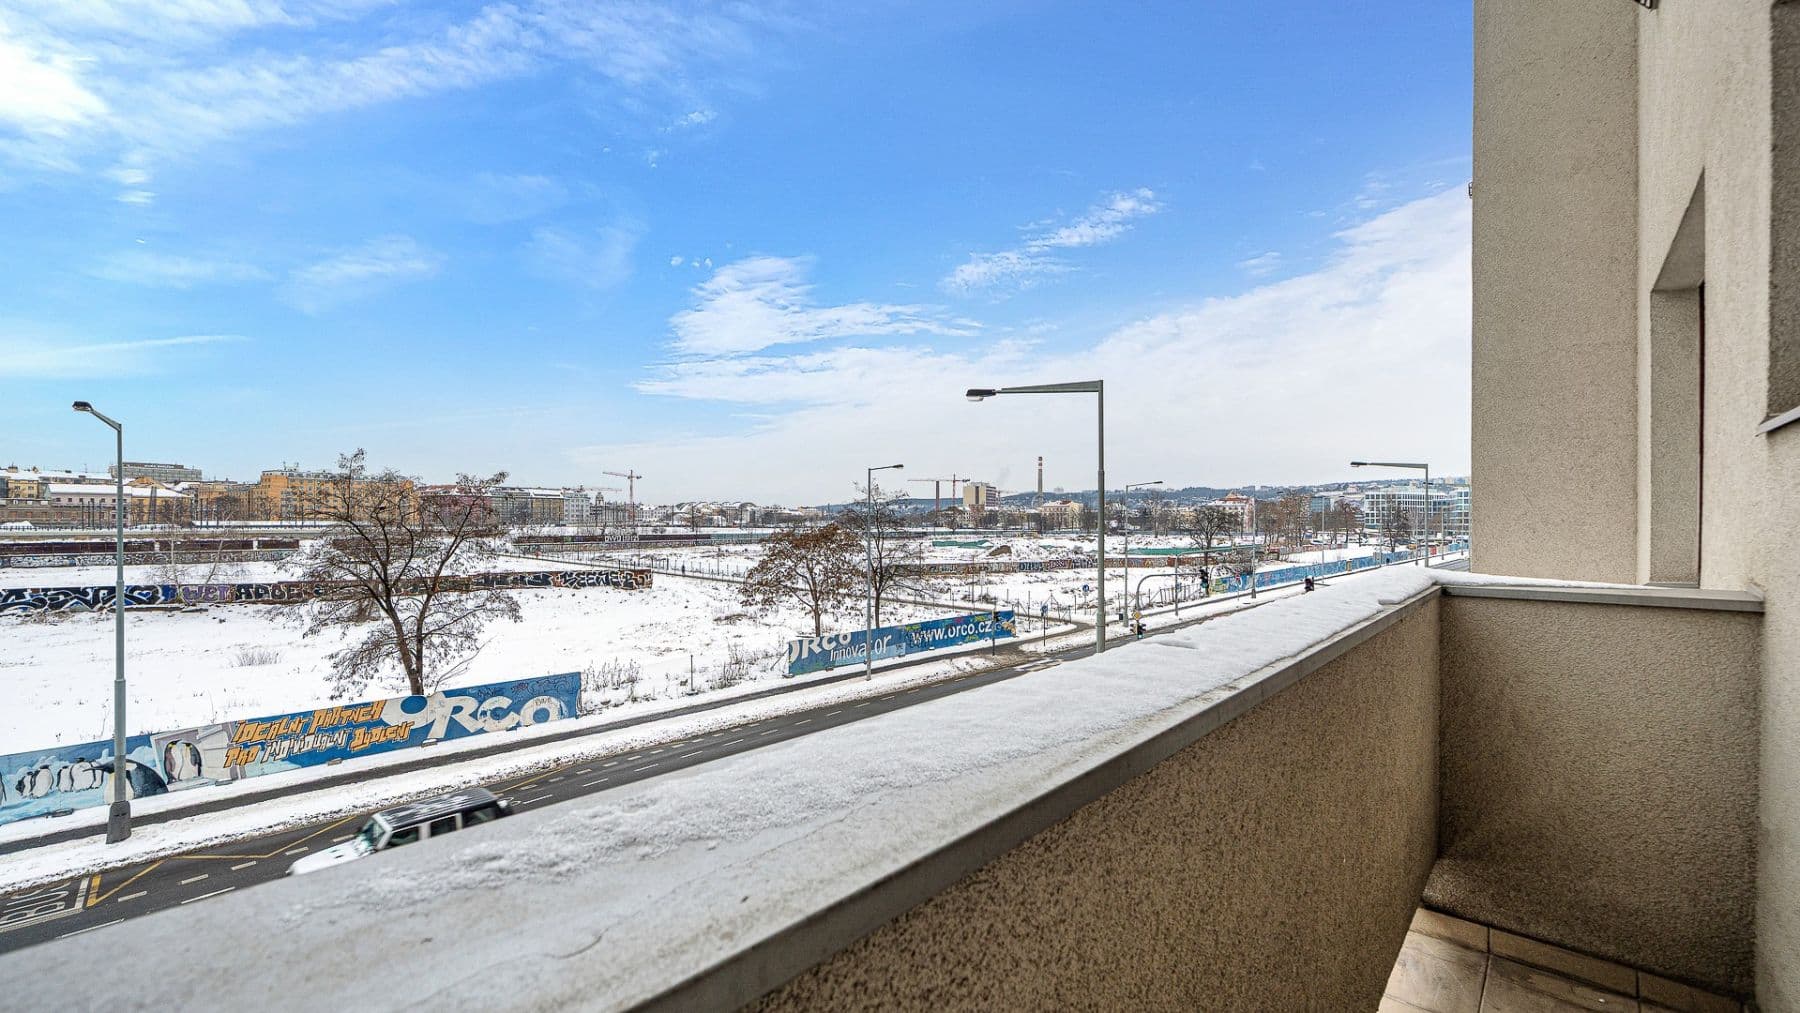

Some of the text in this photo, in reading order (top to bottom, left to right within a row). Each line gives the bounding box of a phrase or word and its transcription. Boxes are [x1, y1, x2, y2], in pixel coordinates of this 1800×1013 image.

[912, 620, 992, 644] www.orco.cz
[829, 634, 892, 662] Innovaor
[382, 691, 568, 739] ORCO
